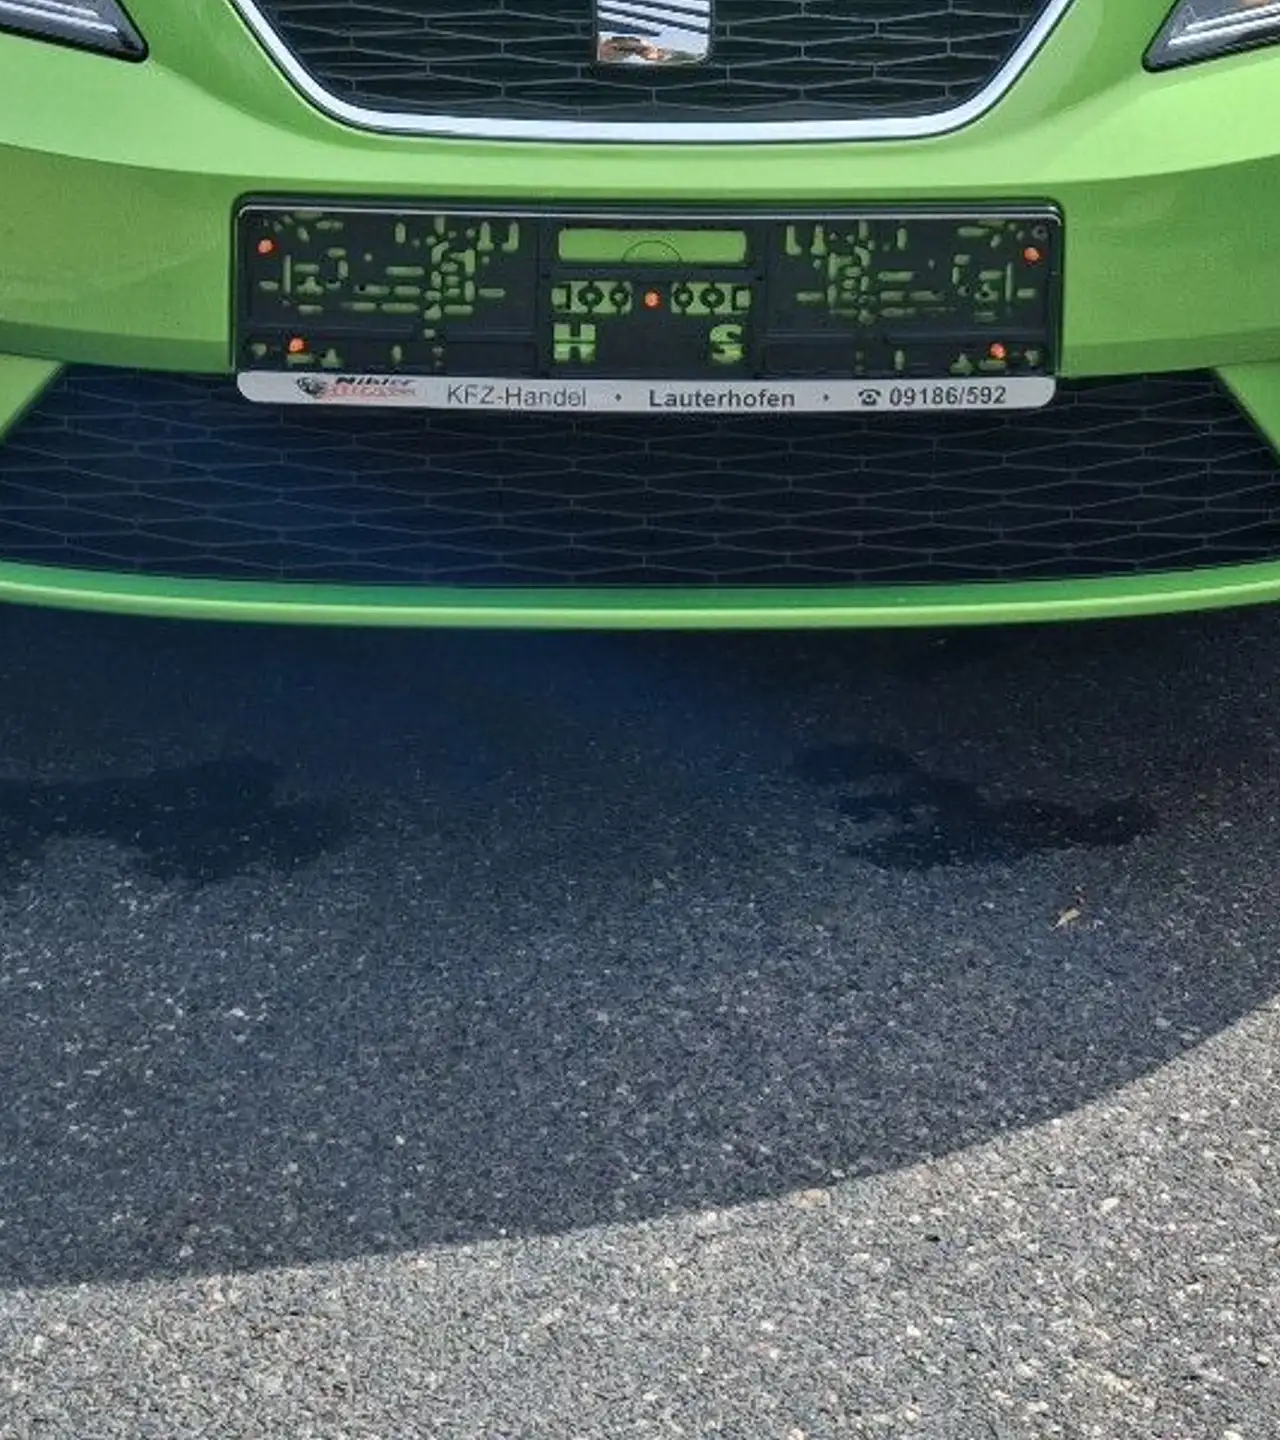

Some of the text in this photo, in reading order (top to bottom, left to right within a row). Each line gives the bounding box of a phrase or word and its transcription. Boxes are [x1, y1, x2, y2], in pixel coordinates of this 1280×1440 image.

[446, 383, 1007, 408] KFZ-Handel Lauterhofen 09186/592
